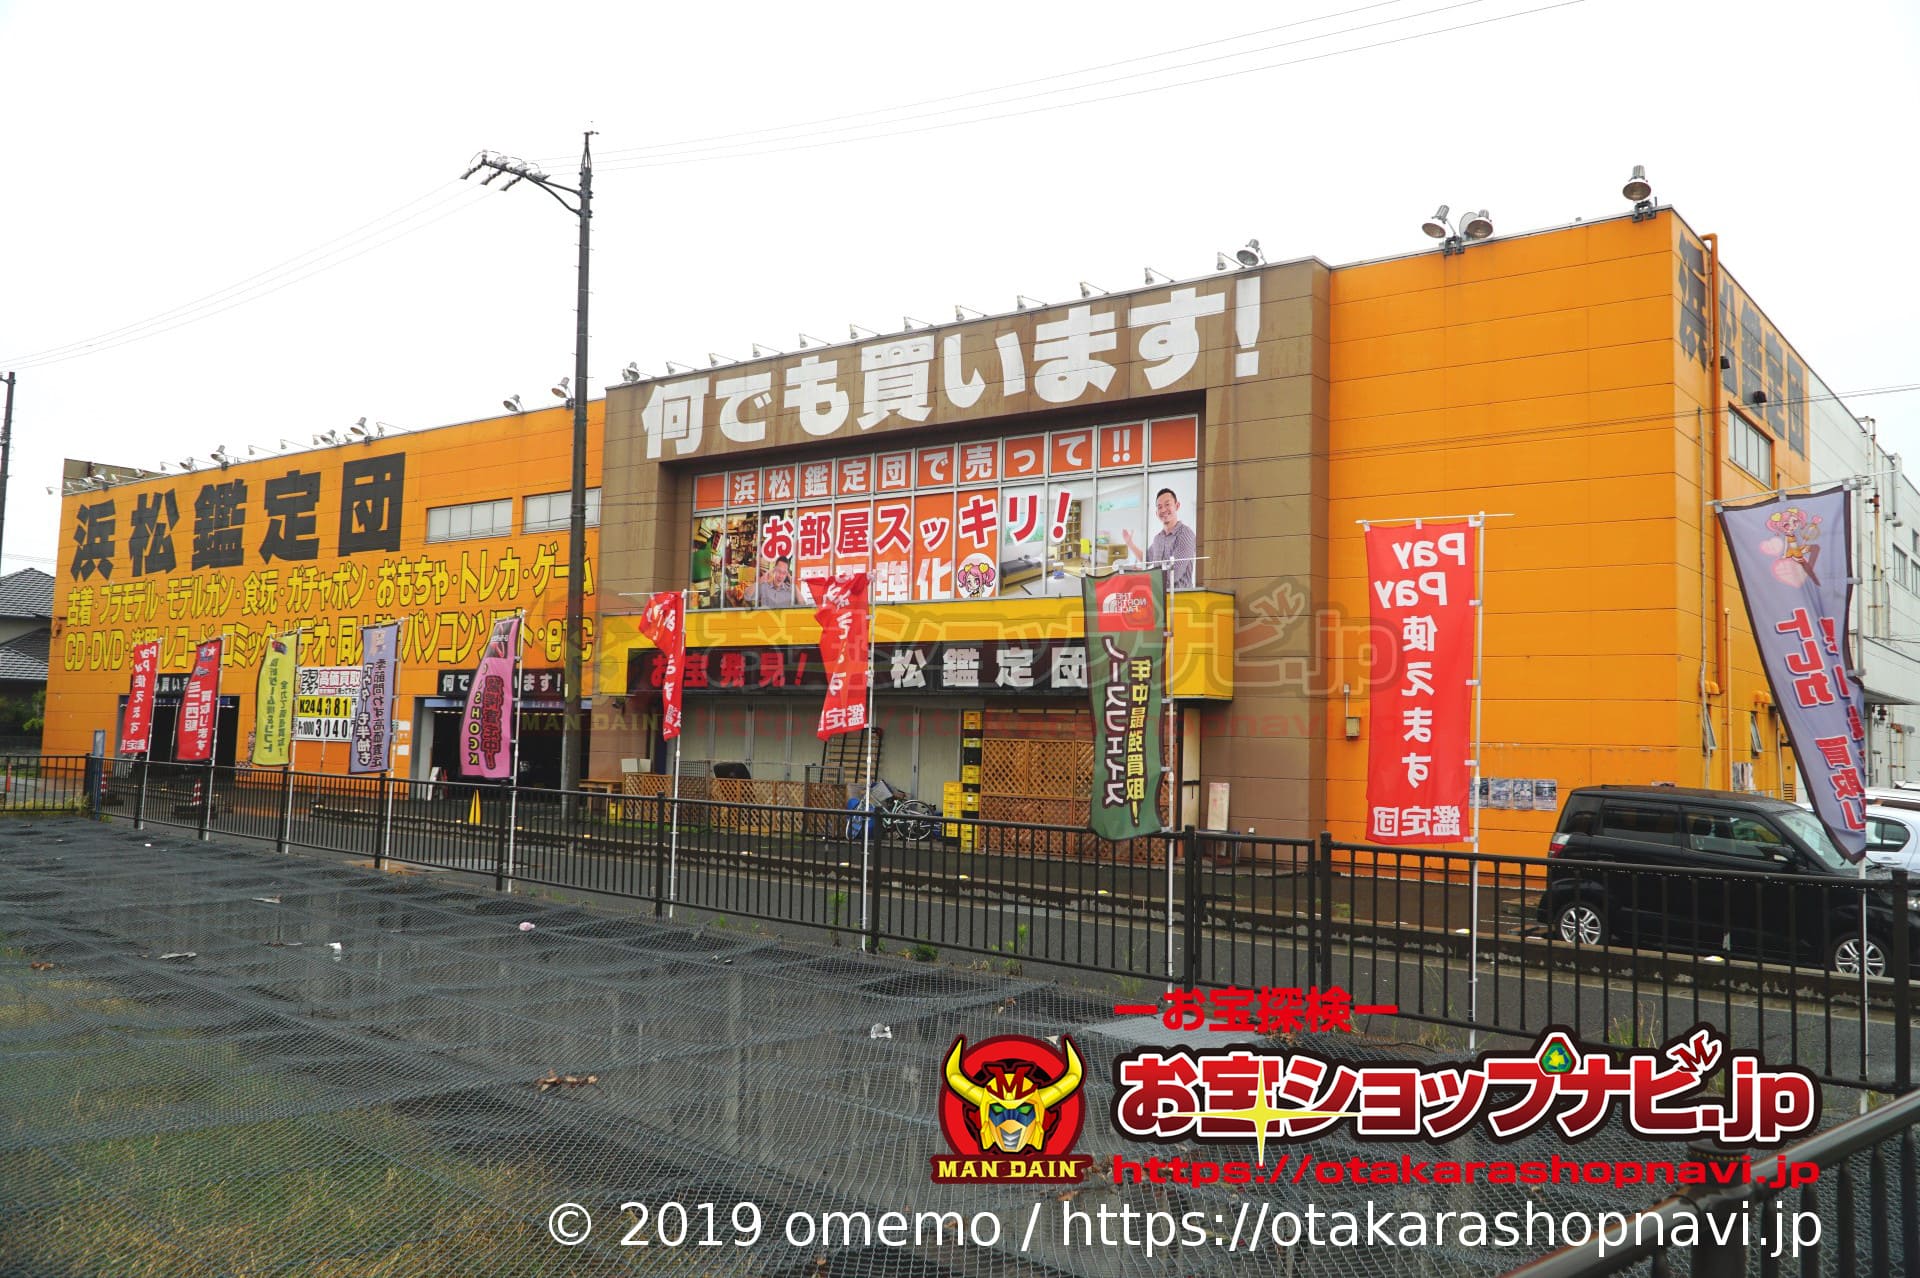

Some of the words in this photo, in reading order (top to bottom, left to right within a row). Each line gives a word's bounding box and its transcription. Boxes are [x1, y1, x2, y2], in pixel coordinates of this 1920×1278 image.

[71, 452, 405, 581] 浜松鑑定団
[799, 557, 952, 605] 買強化
[867, 645, 1088, 689] 松鑑定団
